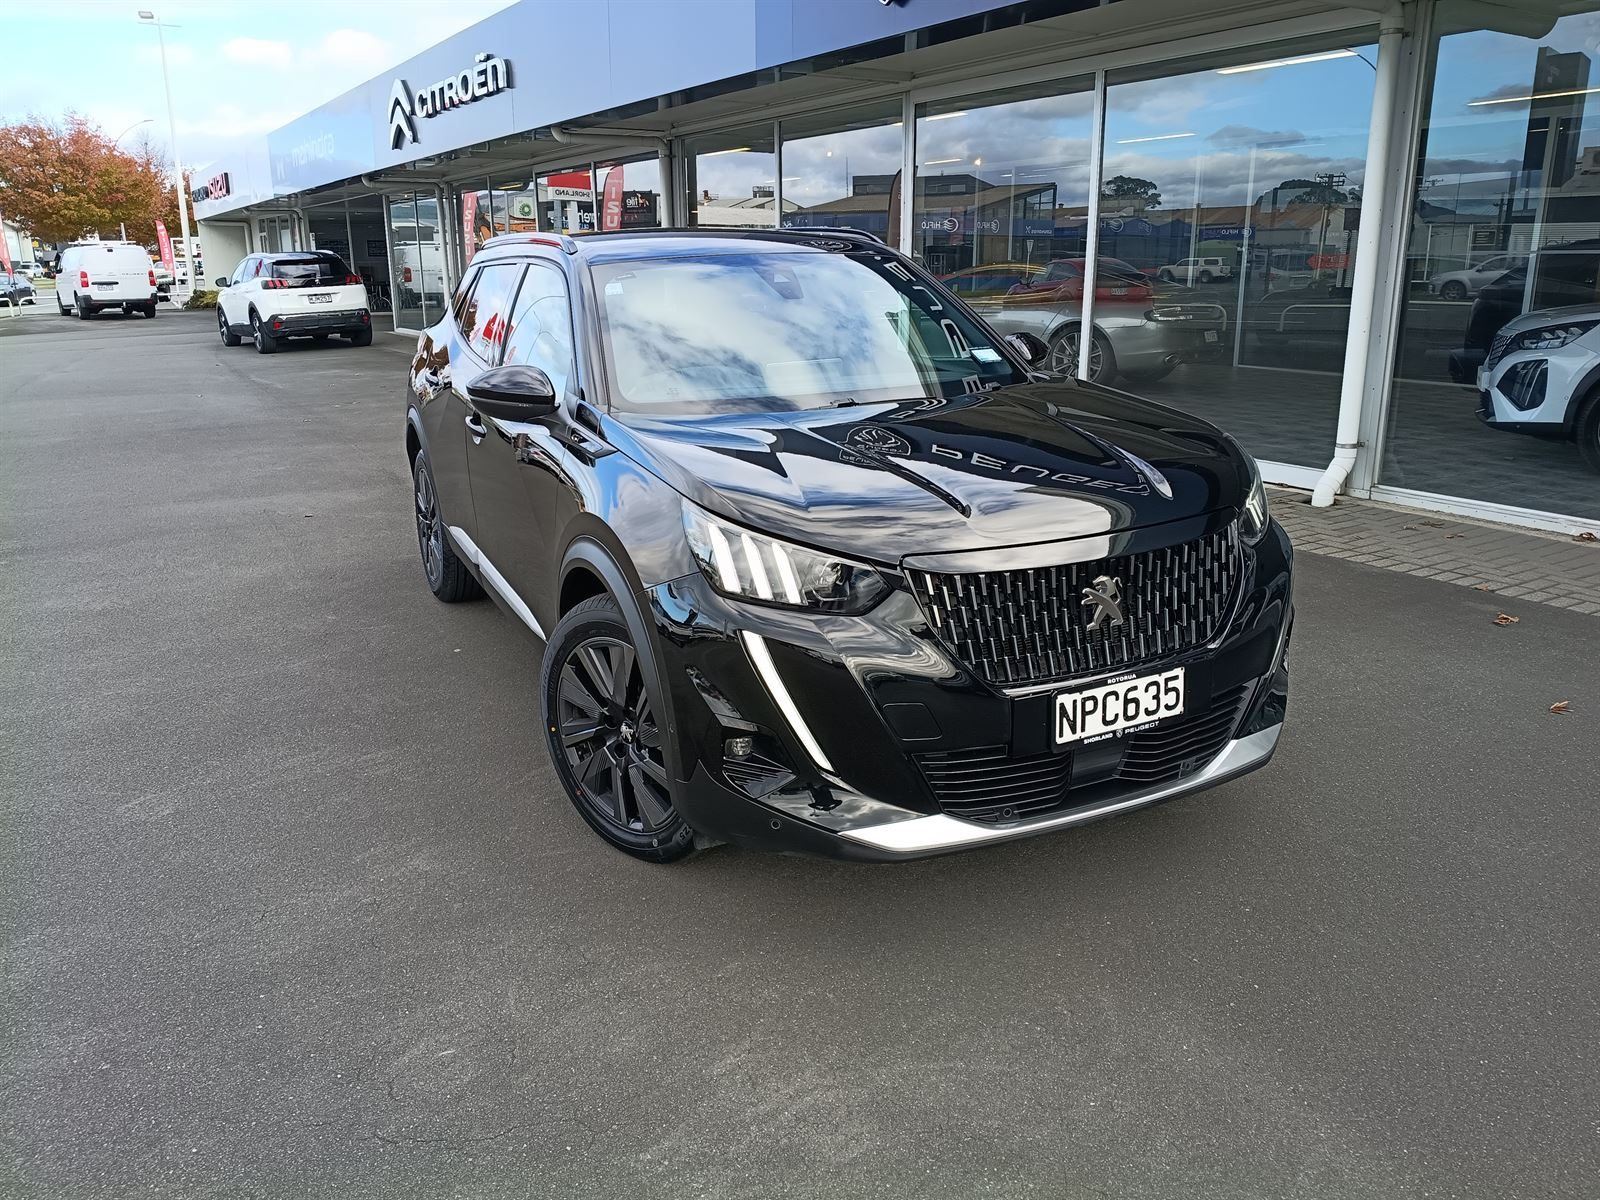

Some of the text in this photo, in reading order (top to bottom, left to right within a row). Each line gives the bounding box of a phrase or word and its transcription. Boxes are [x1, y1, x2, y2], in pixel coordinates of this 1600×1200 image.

[208, 172, 230, 200] ISUZU
[1107, 673, 1137, 685] ROTORUA
[1058, 674, 1181, 738] NPC635
[1083, 720, 1160, 745] SHORLAND PEUGEOT
